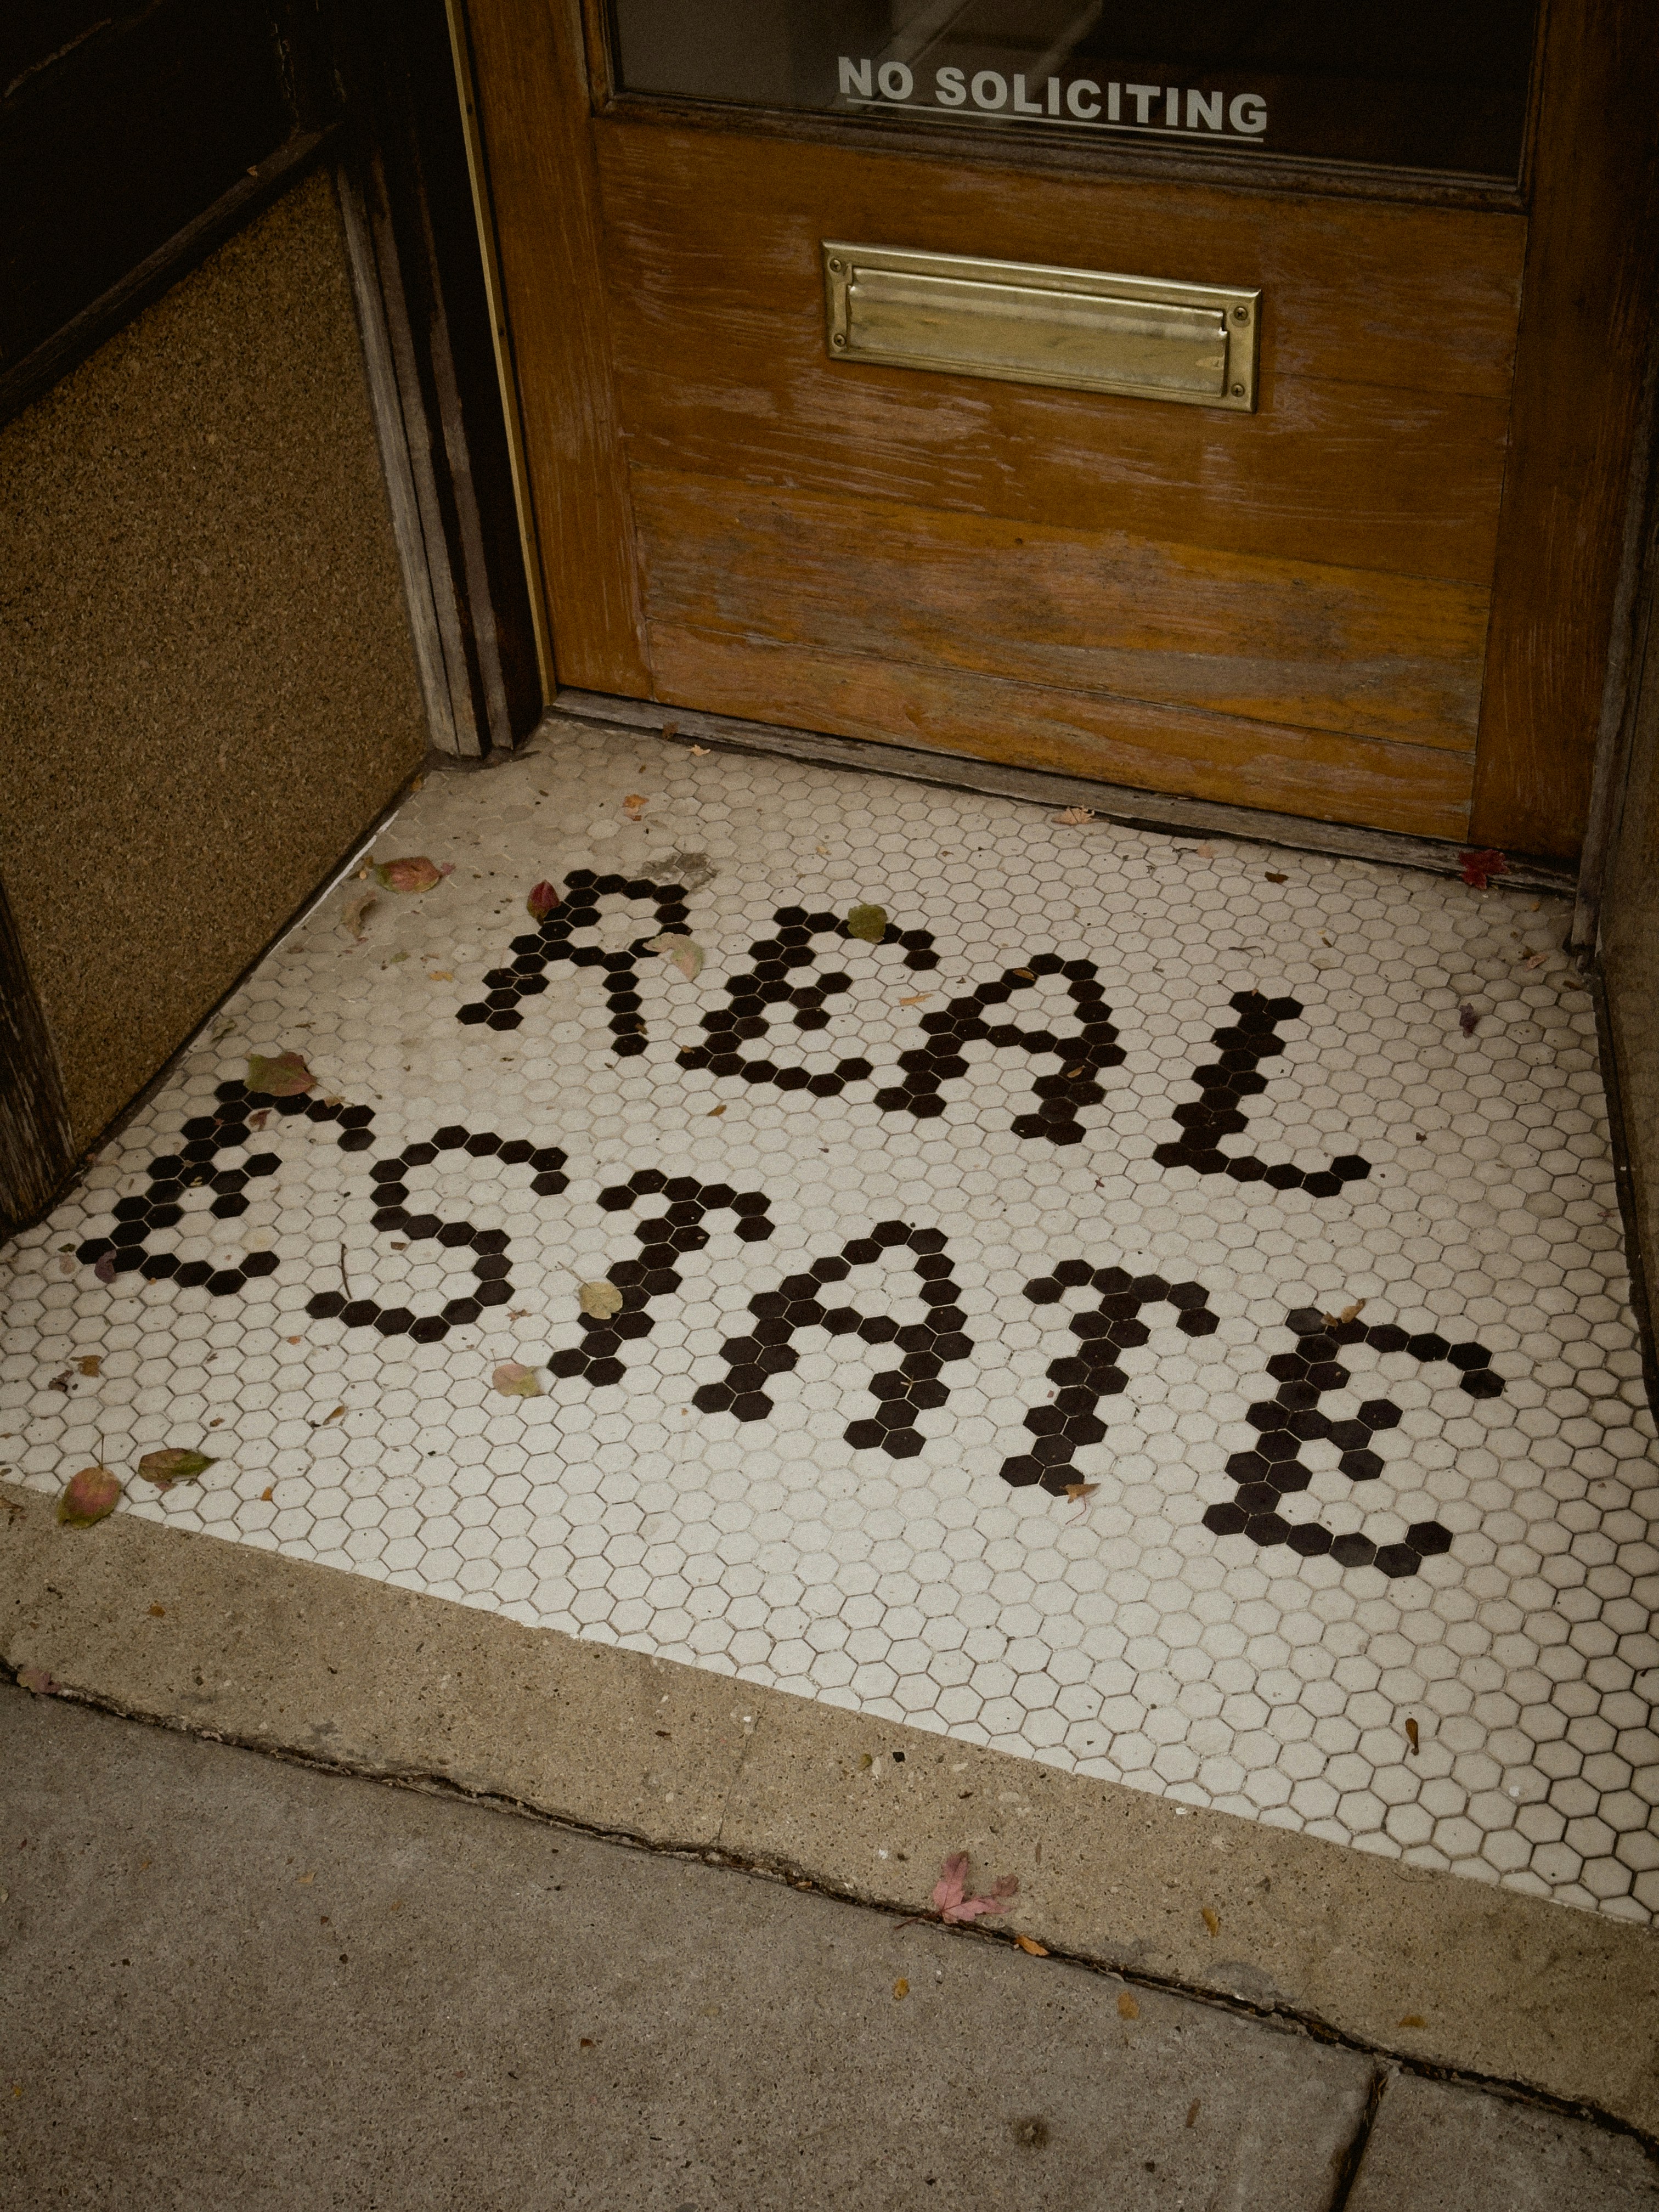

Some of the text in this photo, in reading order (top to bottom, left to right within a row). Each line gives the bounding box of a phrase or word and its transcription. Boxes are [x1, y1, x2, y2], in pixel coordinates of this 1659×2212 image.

[838, 56, 1268, 134] NO SOLICITING
[456, 869, 1371, 1198] REAL
[77, 1079, 1504, 1578] ESTATE
